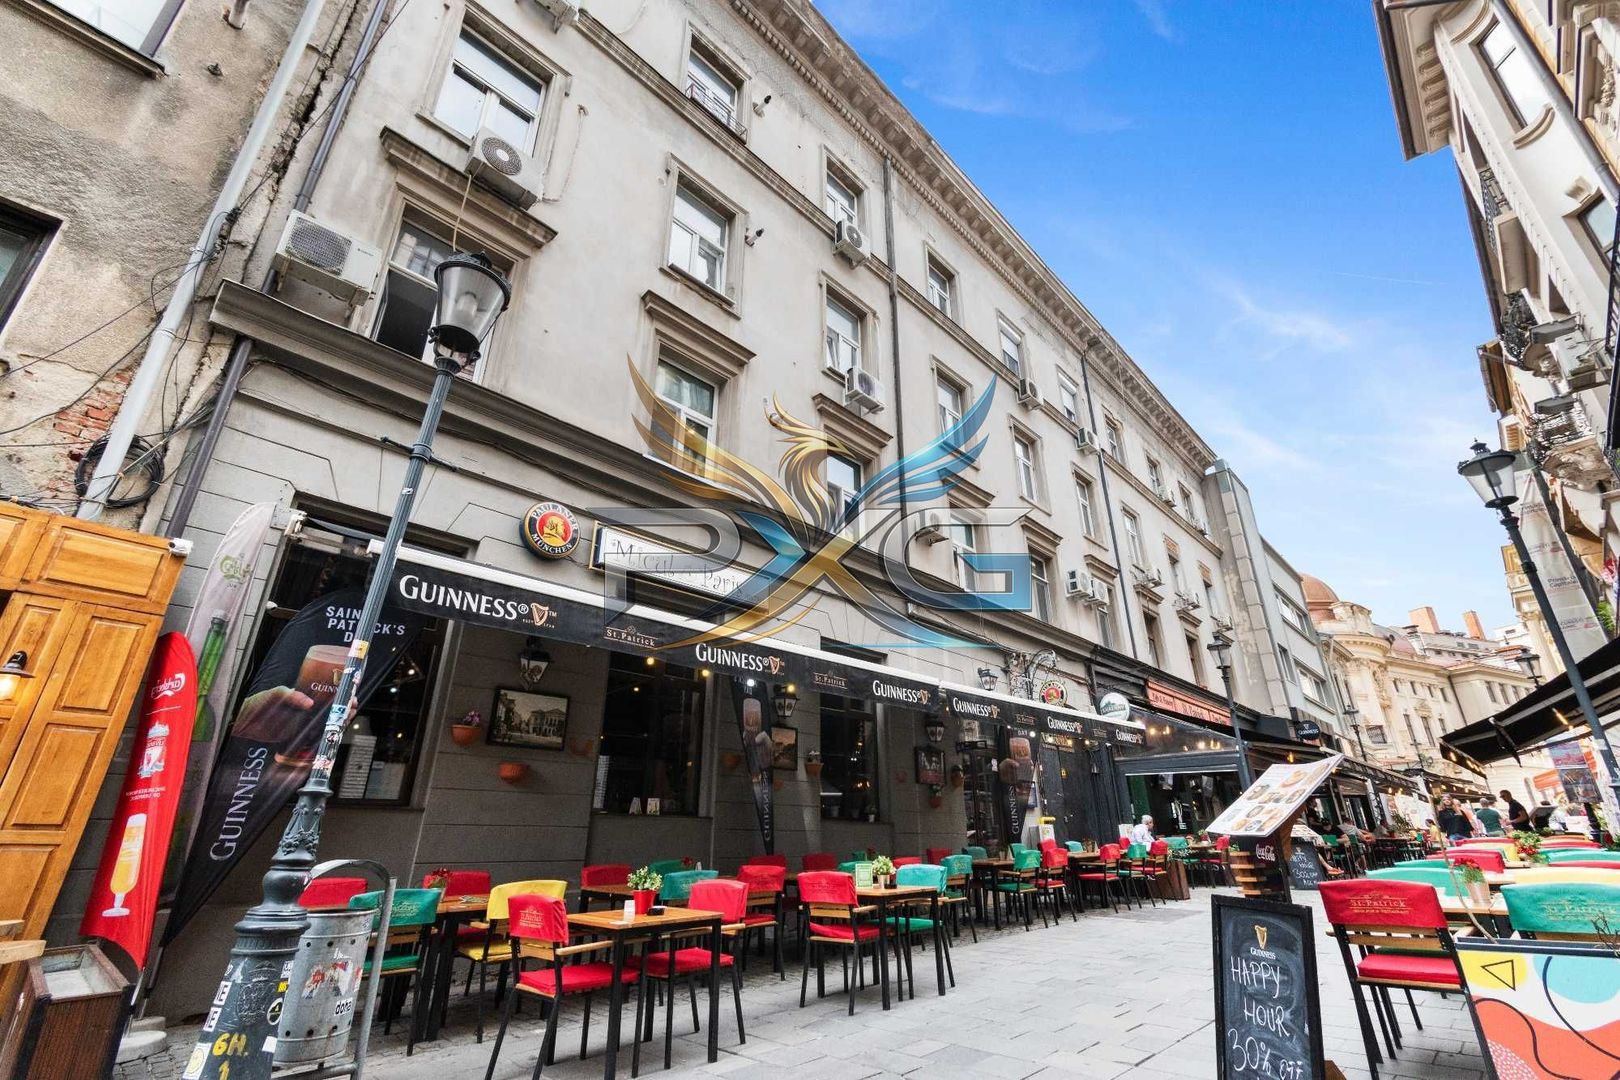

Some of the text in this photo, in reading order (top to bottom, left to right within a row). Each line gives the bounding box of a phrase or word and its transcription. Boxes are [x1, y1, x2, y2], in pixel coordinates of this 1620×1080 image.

[532, 503, 579, 530] PAULANER
[399, 574, 518, 621] GUINNESS
[325, 605, 362, 620] SAIN
[327, 618, 406, 636] PATCK'S
[695, 642, 763, 672] GUINNESS
[310, 682, 342, 694] GUINN
[872, 679, 918, 703] GUINNESS
[953, 696, 989, 717] GUINNESS
[209, 747, 269, 861] GUINNESS
[1250, 946, 1276, 960] GUINNESS
[1230, 956, 1281, 999] HAPPY
[1243, 997, 1292, 1038] HOUR
[1227, 1028, 1304, 1080] 30% OFF
